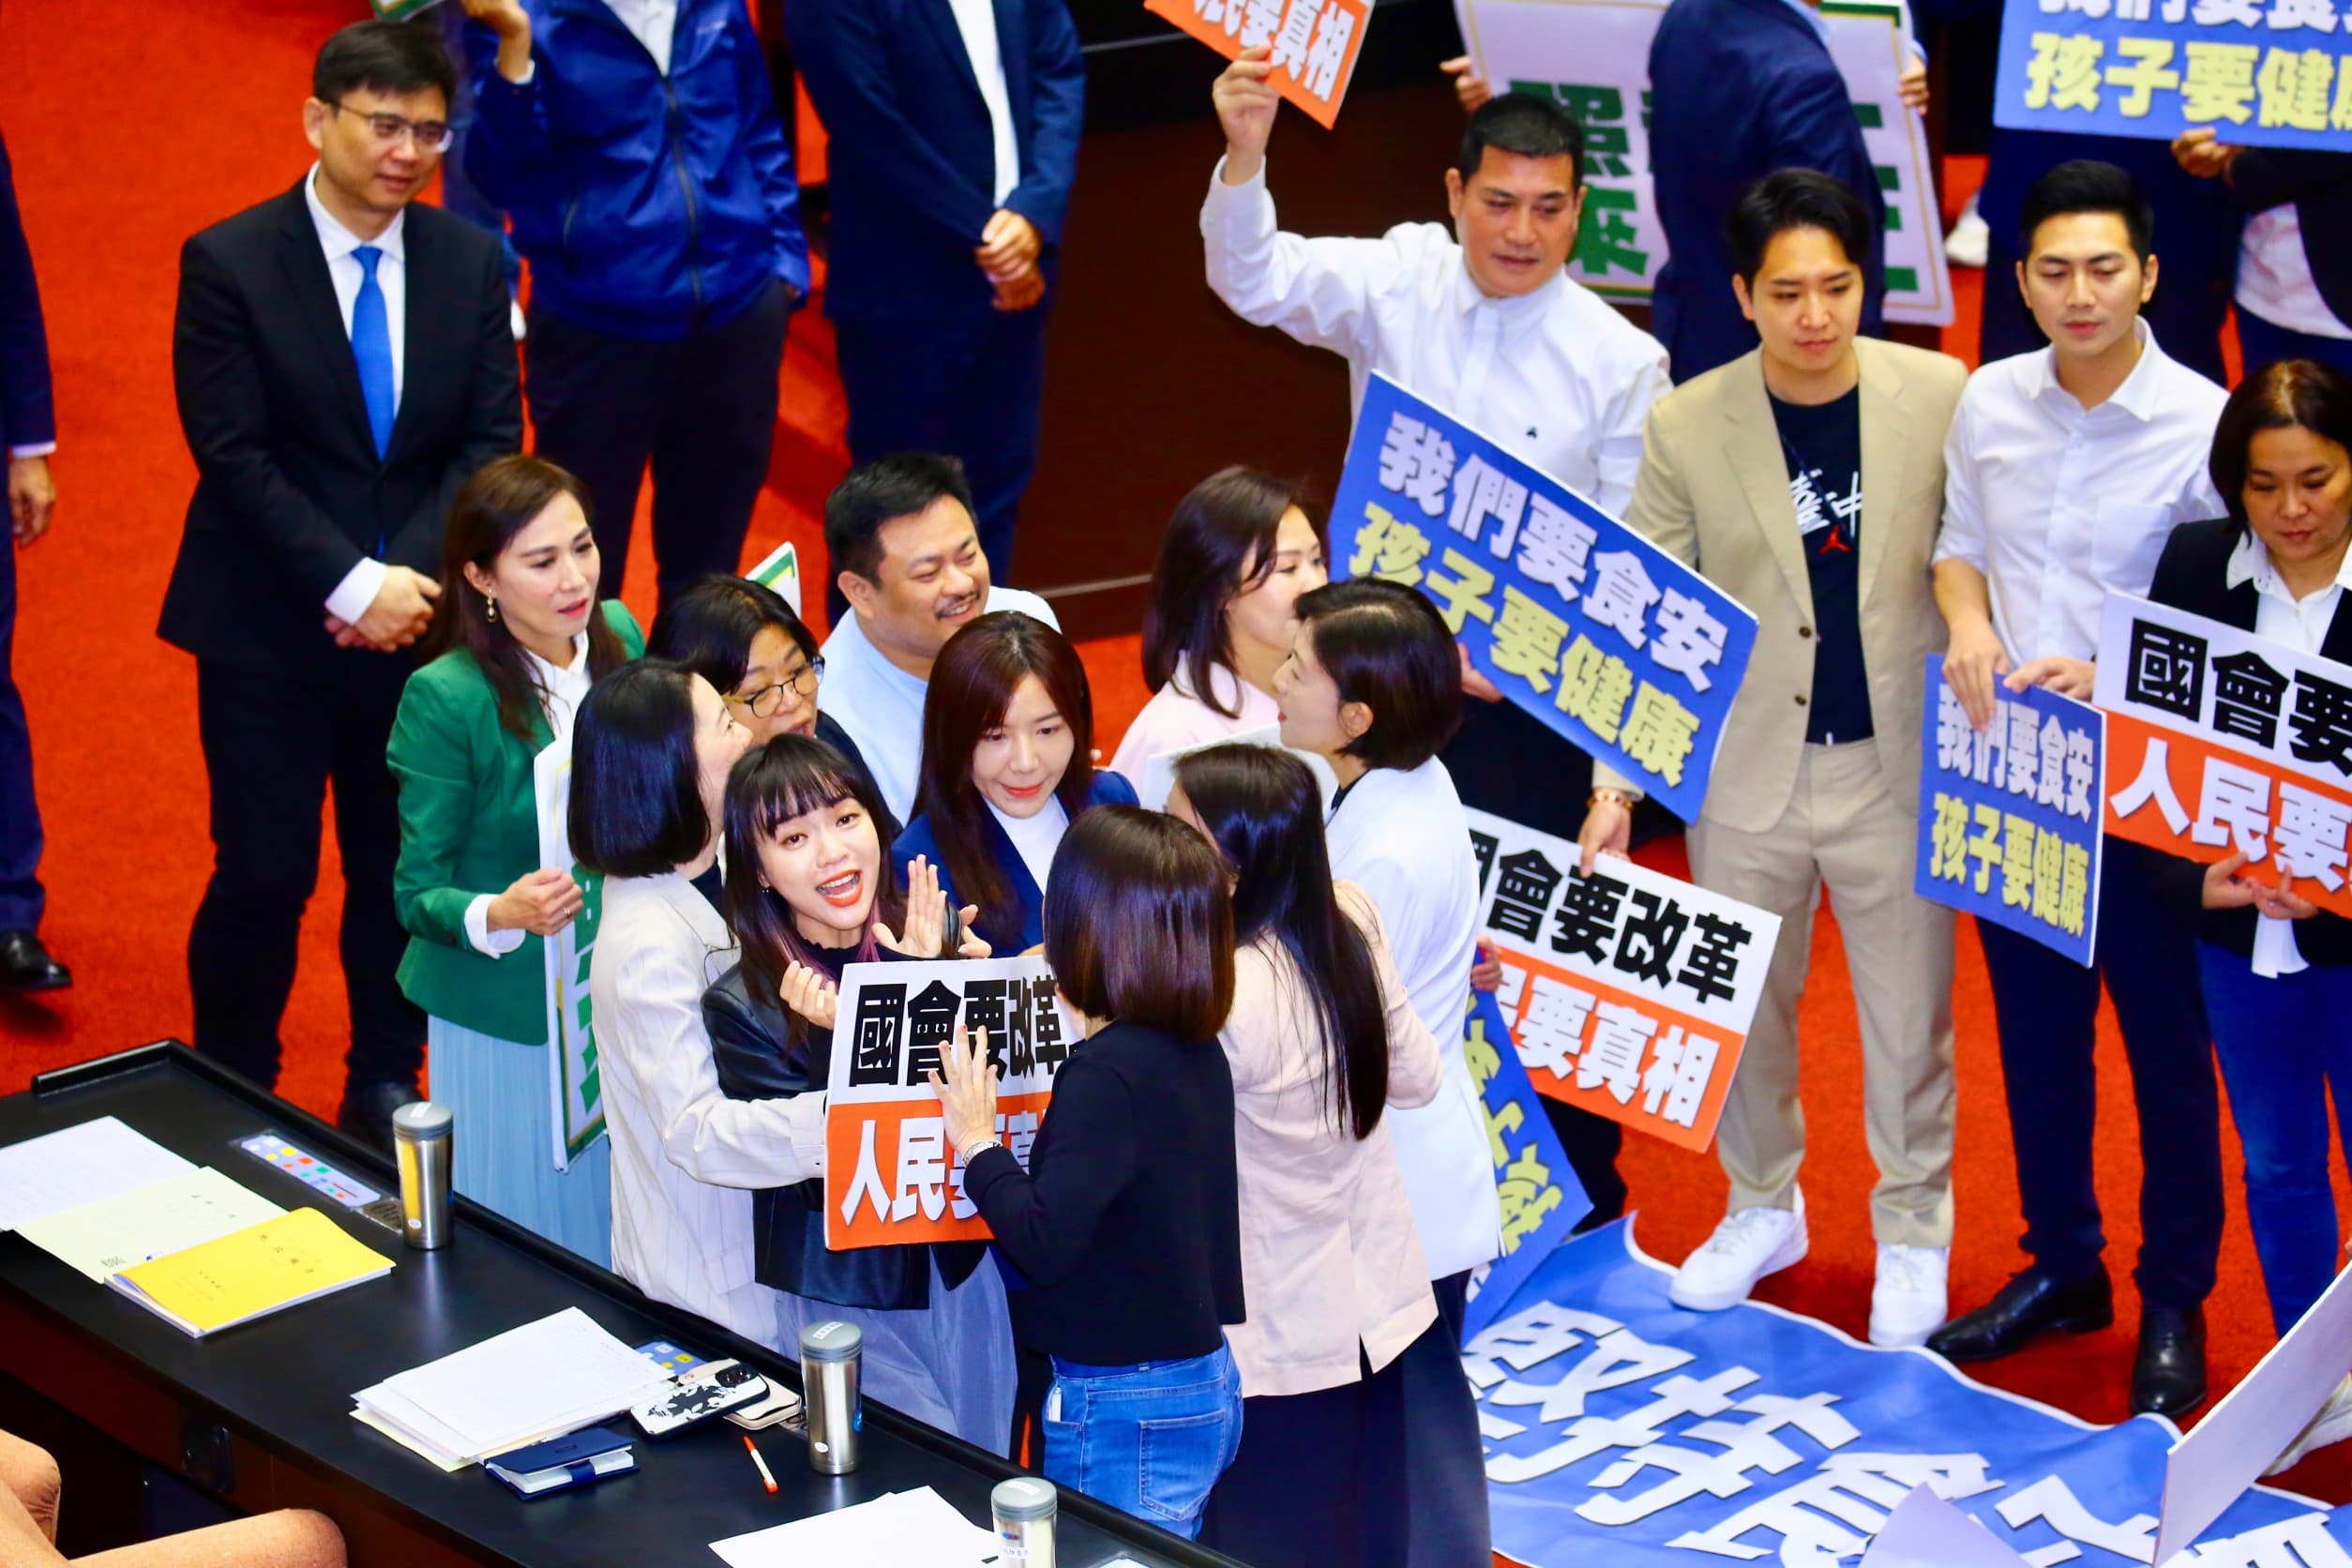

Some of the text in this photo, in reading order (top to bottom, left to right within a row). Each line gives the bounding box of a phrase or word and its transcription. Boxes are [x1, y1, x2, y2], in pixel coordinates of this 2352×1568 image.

[1194, 0, 1354, 102] 要真相
[1379, 411, 1727, 692] 我們要食安
[1349, 502, 1701, 788] 孩子要健康
[1929, 792, 2089, 938] 孩子要健康
[2109, 736, 2352, 893] 人民要
